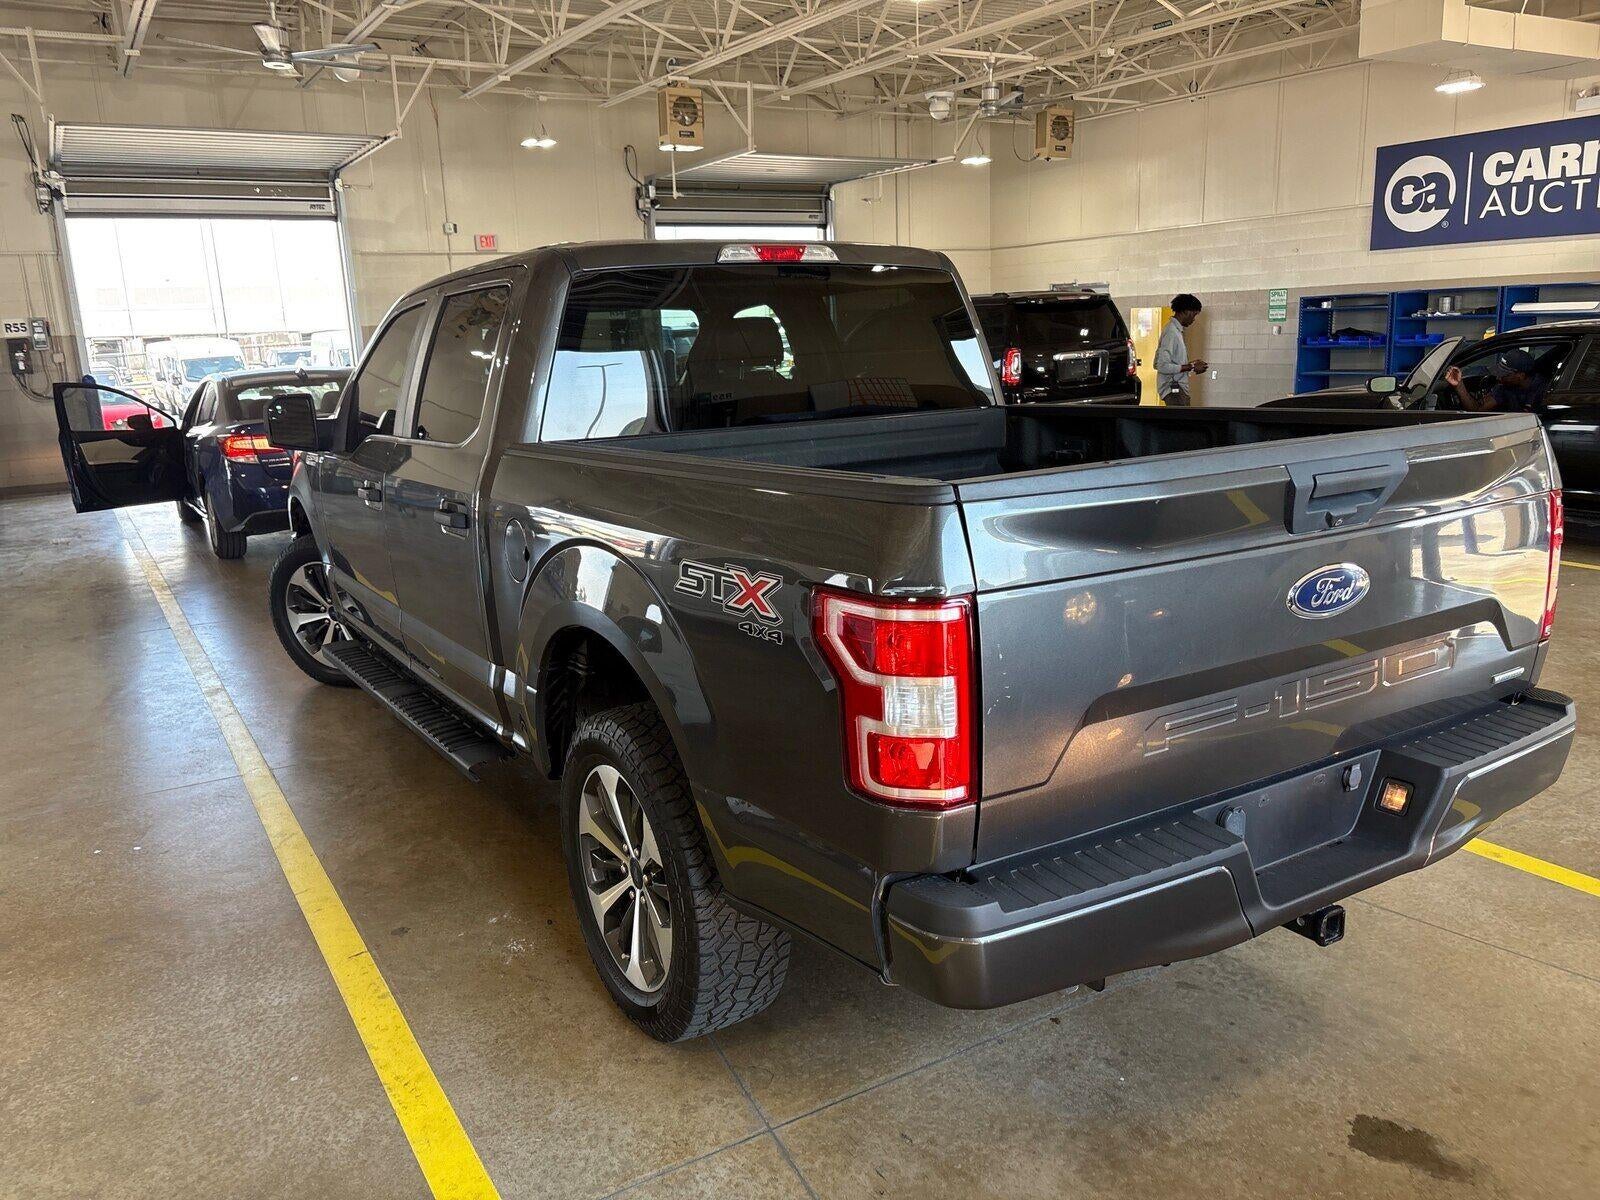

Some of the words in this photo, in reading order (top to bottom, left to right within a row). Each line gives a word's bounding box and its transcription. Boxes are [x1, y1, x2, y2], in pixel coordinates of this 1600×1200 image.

[480, 234, 496, 248] EXIT
[4, 322, 27, 333] R55
[674, 559, 783, 627] STX
[1310, 575, 1356, 608] Ford
[1144, 636, 1455, 757] F-150
